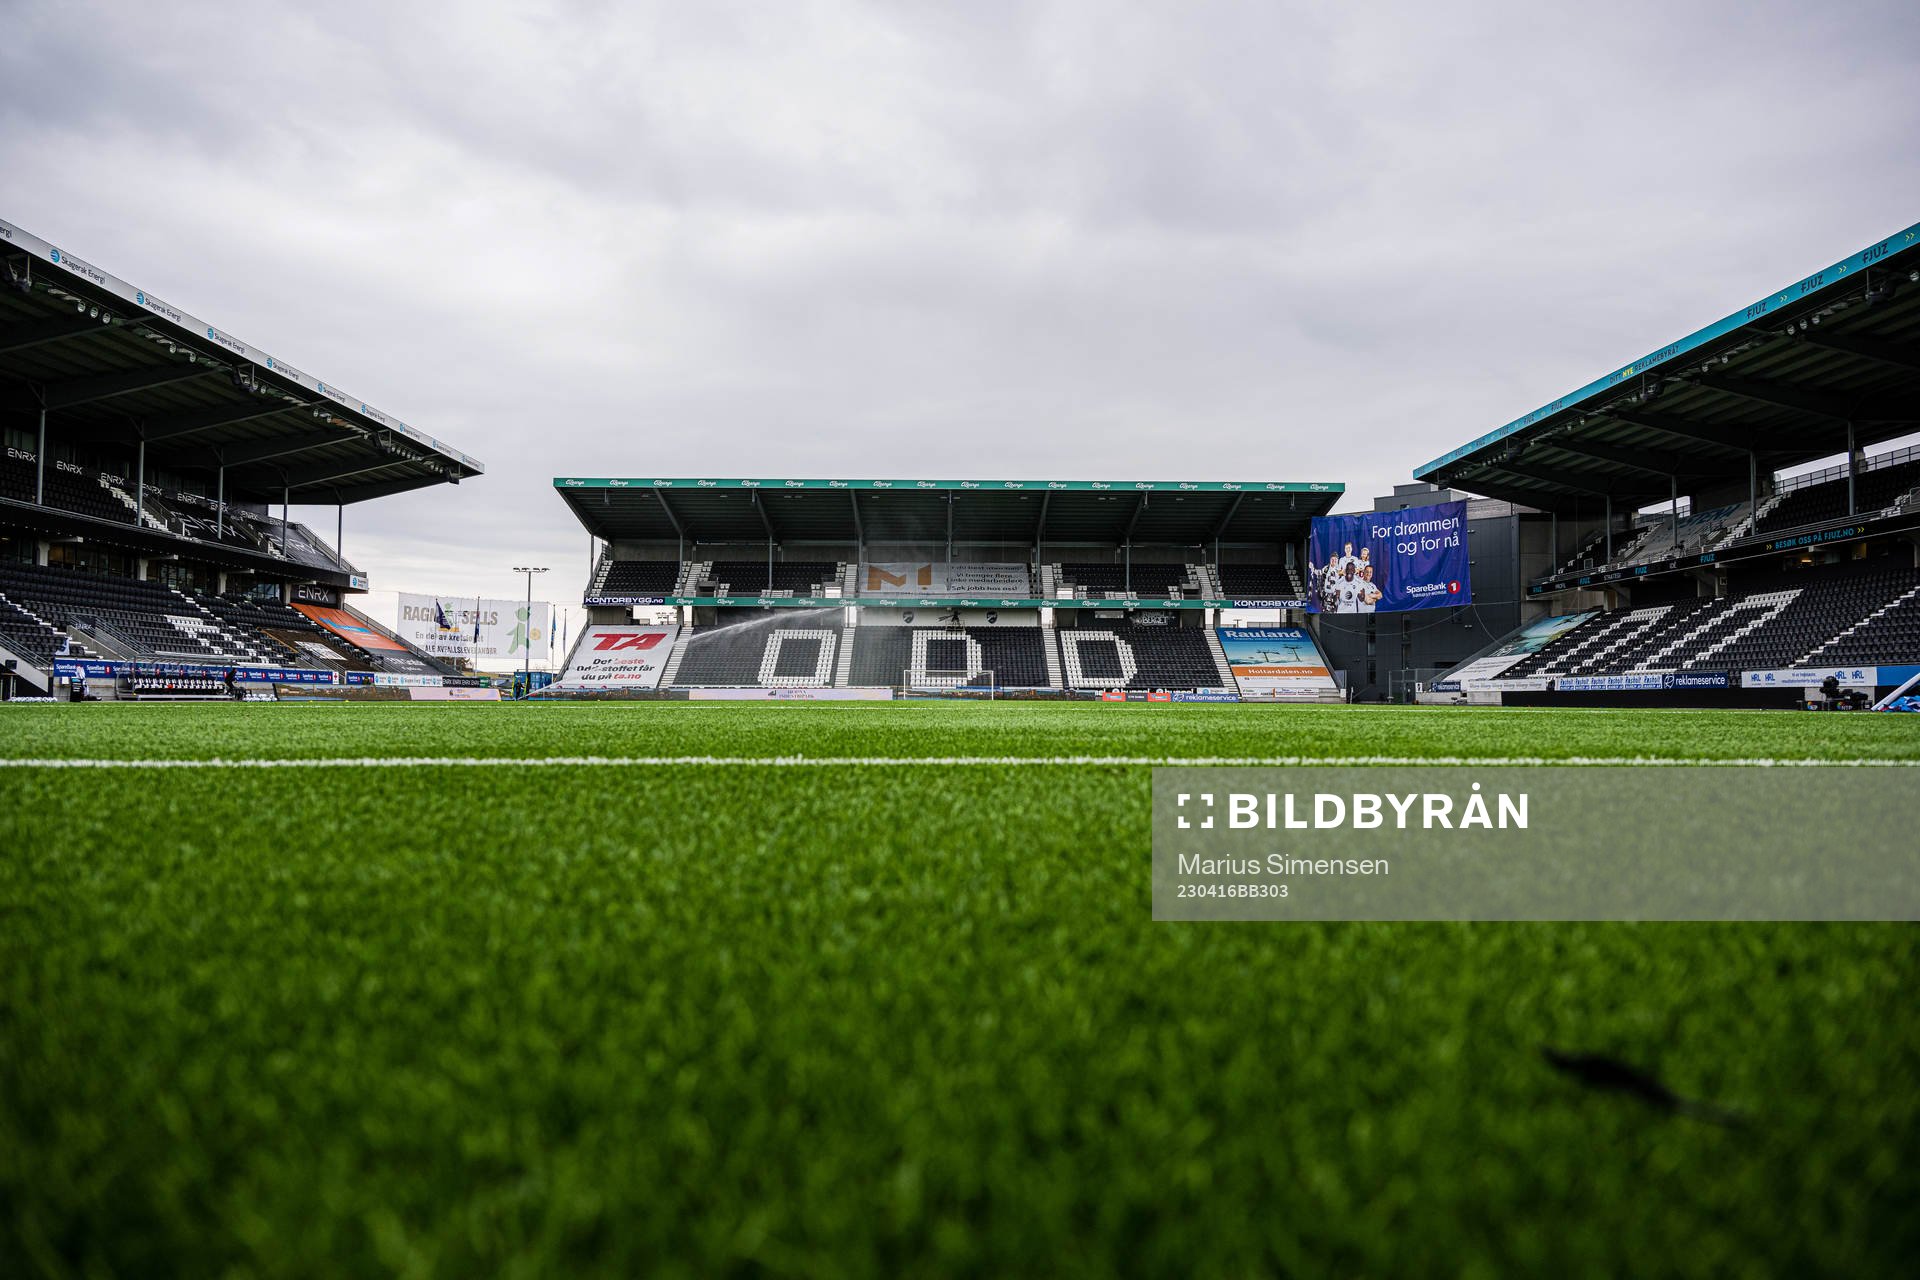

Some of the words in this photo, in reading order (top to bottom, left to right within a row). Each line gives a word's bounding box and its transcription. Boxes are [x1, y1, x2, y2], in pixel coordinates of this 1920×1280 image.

[1862, 243, 1888, 264] FJUZ
[62, 256, 87, 276] Skagerak
[88, 269, 105, 285] Energi
[1800, 274, 1824, 293] FJUZ
[145, 297, 166, 314] Skagerak
[166, 310, 182, 322] Energi
[1747, 302, 1766, 319] FJUZ
[8, 448, 36, 463] ENRX
[56, 460, 84, 475] ENRX
[100, 472, 125, 486] ENRX
[177, 493, 198, 505] ENRX
[1372, 524, 1392, 538] For
[1394, 517, 1459, 536] drømmen
[1397, 541, 1417, 556] og
[1421, 536, 1440, 550] for
[1444, 531, 1460, 547] nå
[1776, 539, 1796, 549] BESØK
[1799, 536, 1812, 545] OSS
[1813, 532, 1822, 542] PÅ
[1824, 528, 1854, 541] FJUZ.NO
[298, 584, 328, 601] ENRX
[1406, 581, 1446, 594] SpareBank
[462, 611, 498, 626] SELLS
[592, 633, 667, 650] TA
[1224, 630, 1302, 638] Rauland
[1676, 675, 1725, 686] reklameservice
[1751, 673, 1760, 682] HRL
[1765, 673, 1775, 681] HRL
[1835, 671, 1847, 679] HRL
[1852, 670, 1864, 679] HRL
